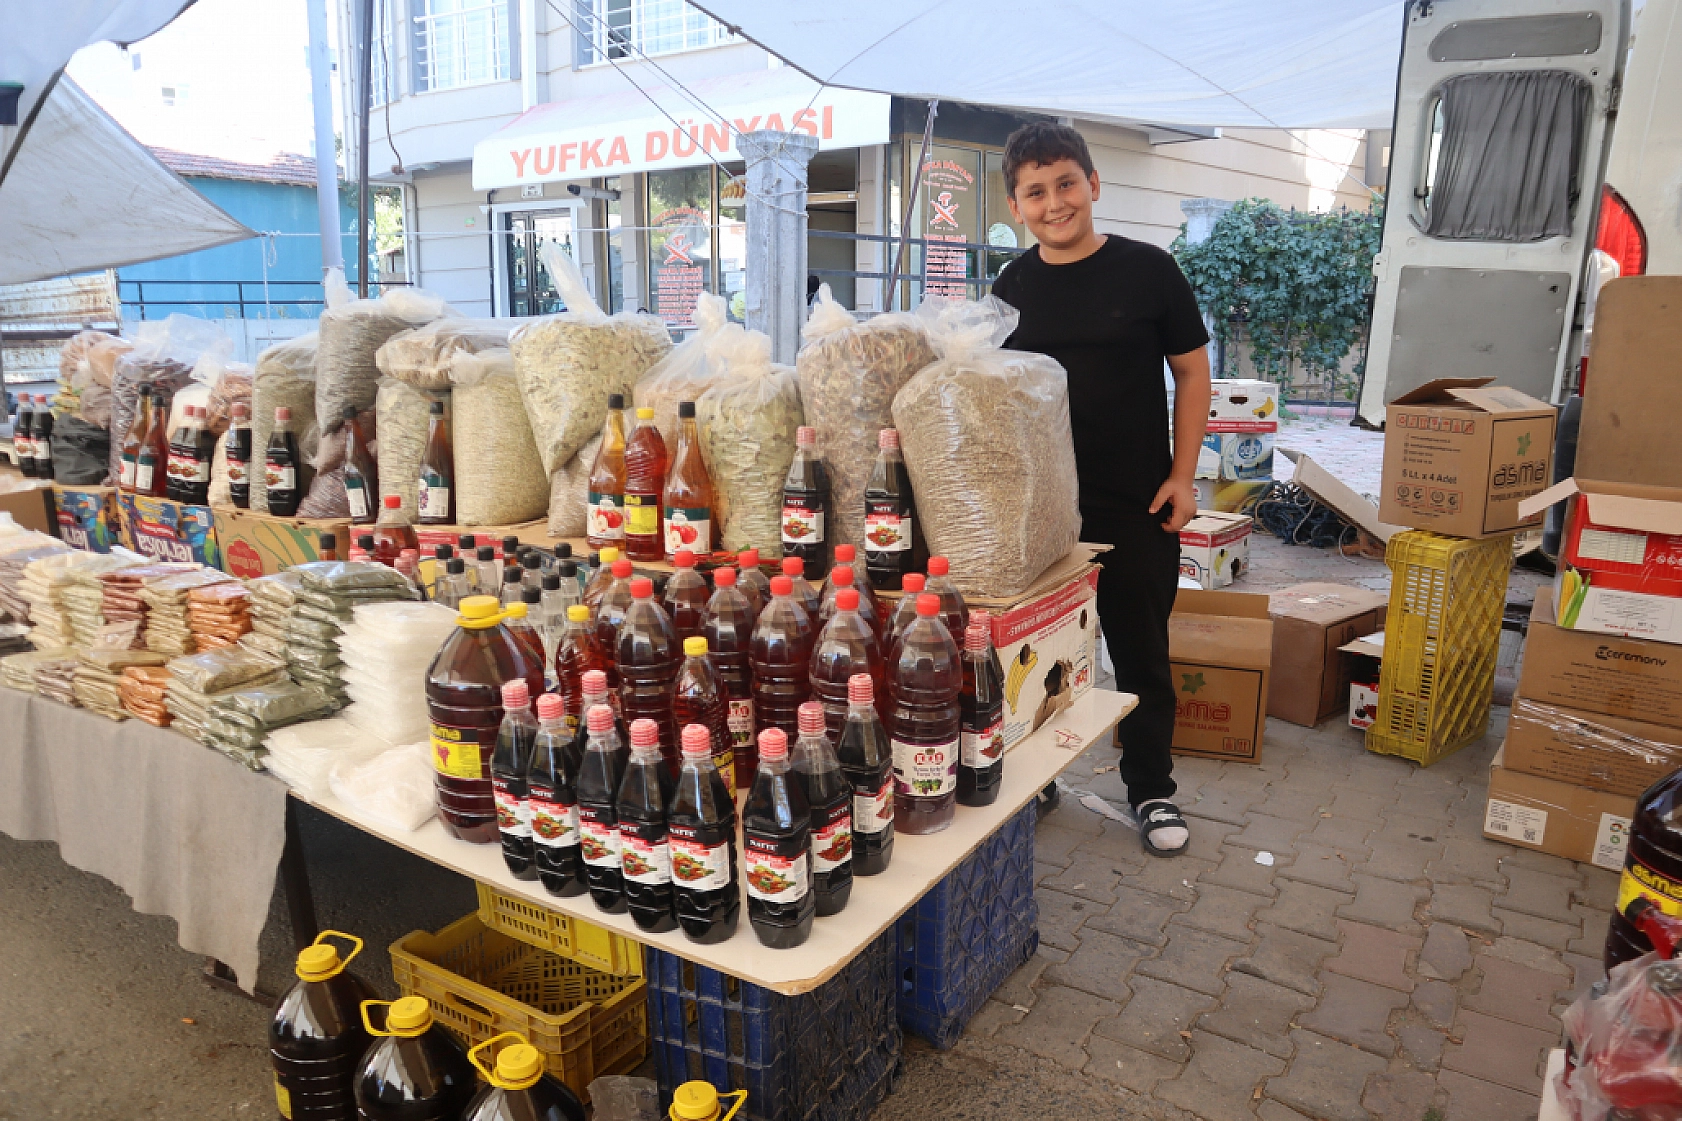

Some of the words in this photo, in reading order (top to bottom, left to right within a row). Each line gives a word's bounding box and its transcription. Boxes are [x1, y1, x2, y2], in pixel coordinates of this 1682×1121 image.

[510, 135, 631, 178] YUFKA
[1429, 473, 1435, 481] 4
[1493, 459, 1546, 488] asma
[1606, 649, 1668, 667] ceremony
